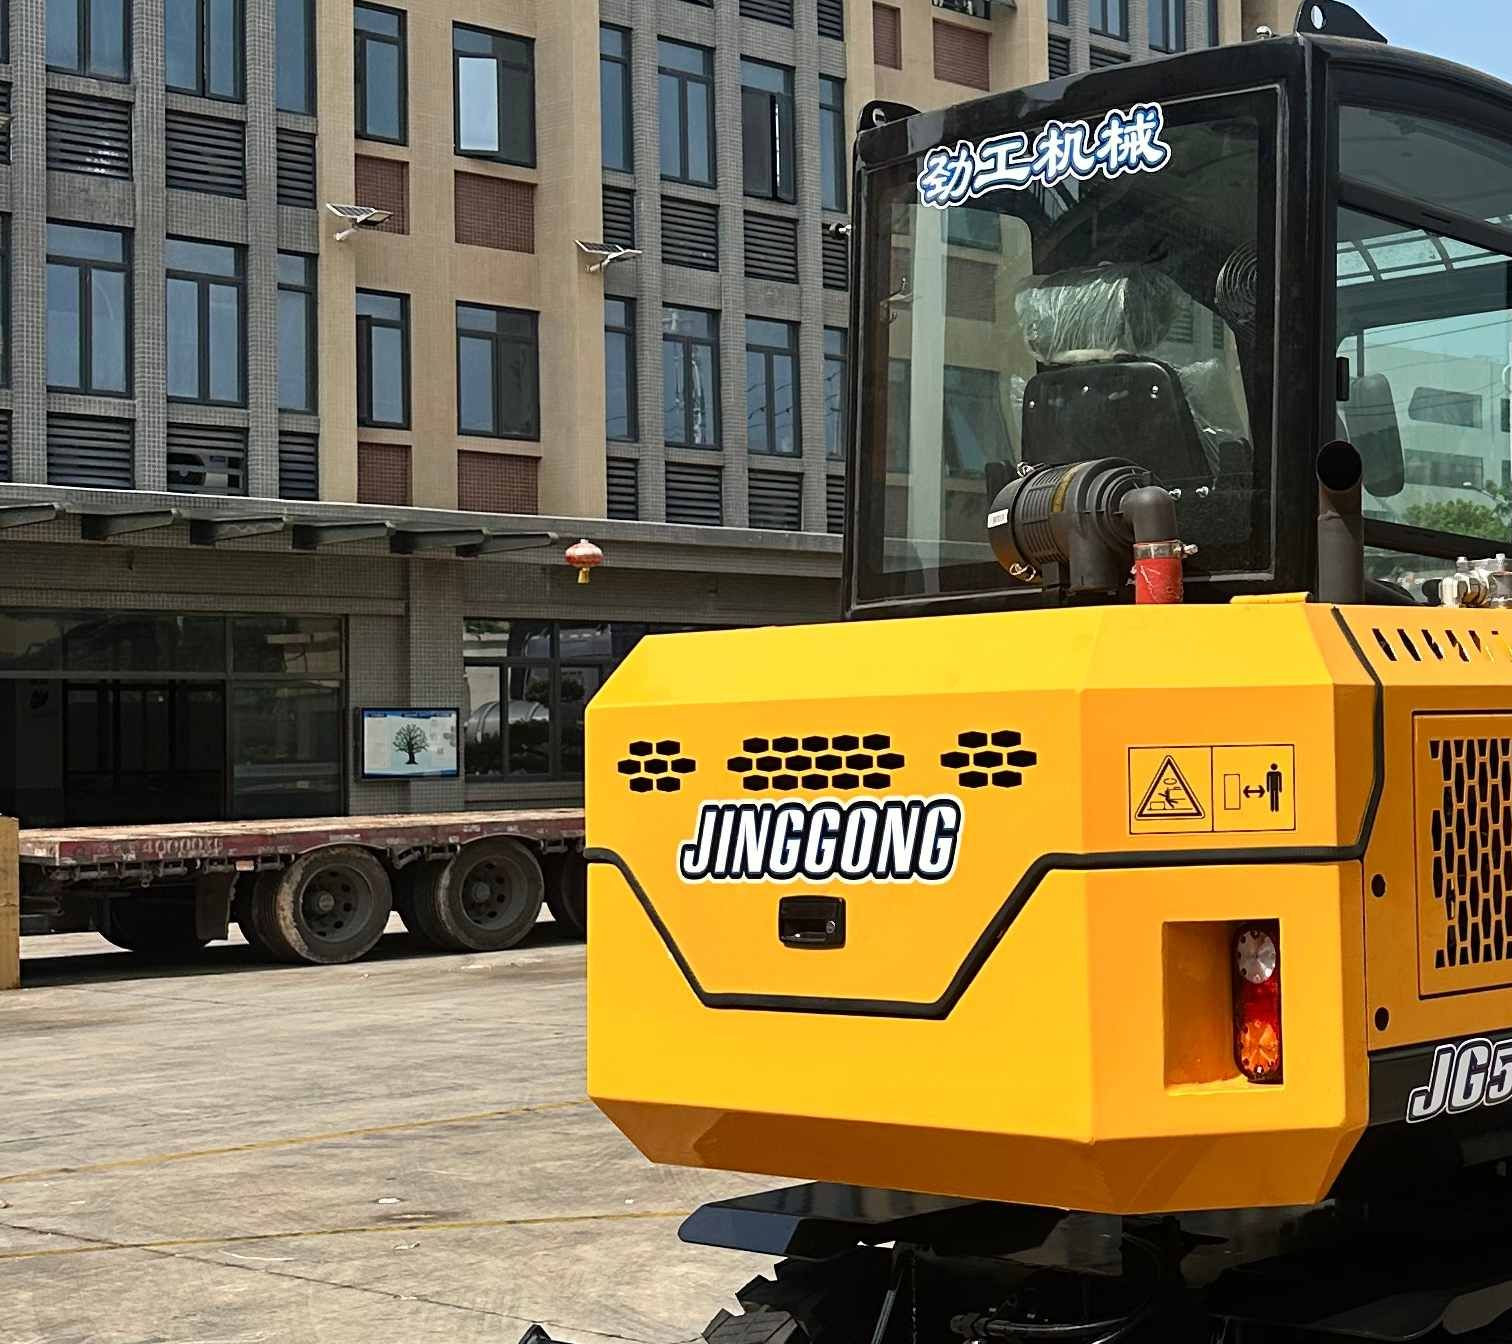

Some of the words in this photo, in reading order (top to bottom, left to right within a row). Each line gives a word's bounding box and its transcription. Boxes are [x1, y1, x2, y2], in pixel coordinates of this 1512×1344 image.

[919, 104, 1169, 207] 劲工机械
[680, 798, 962, 881] JINGGONG
